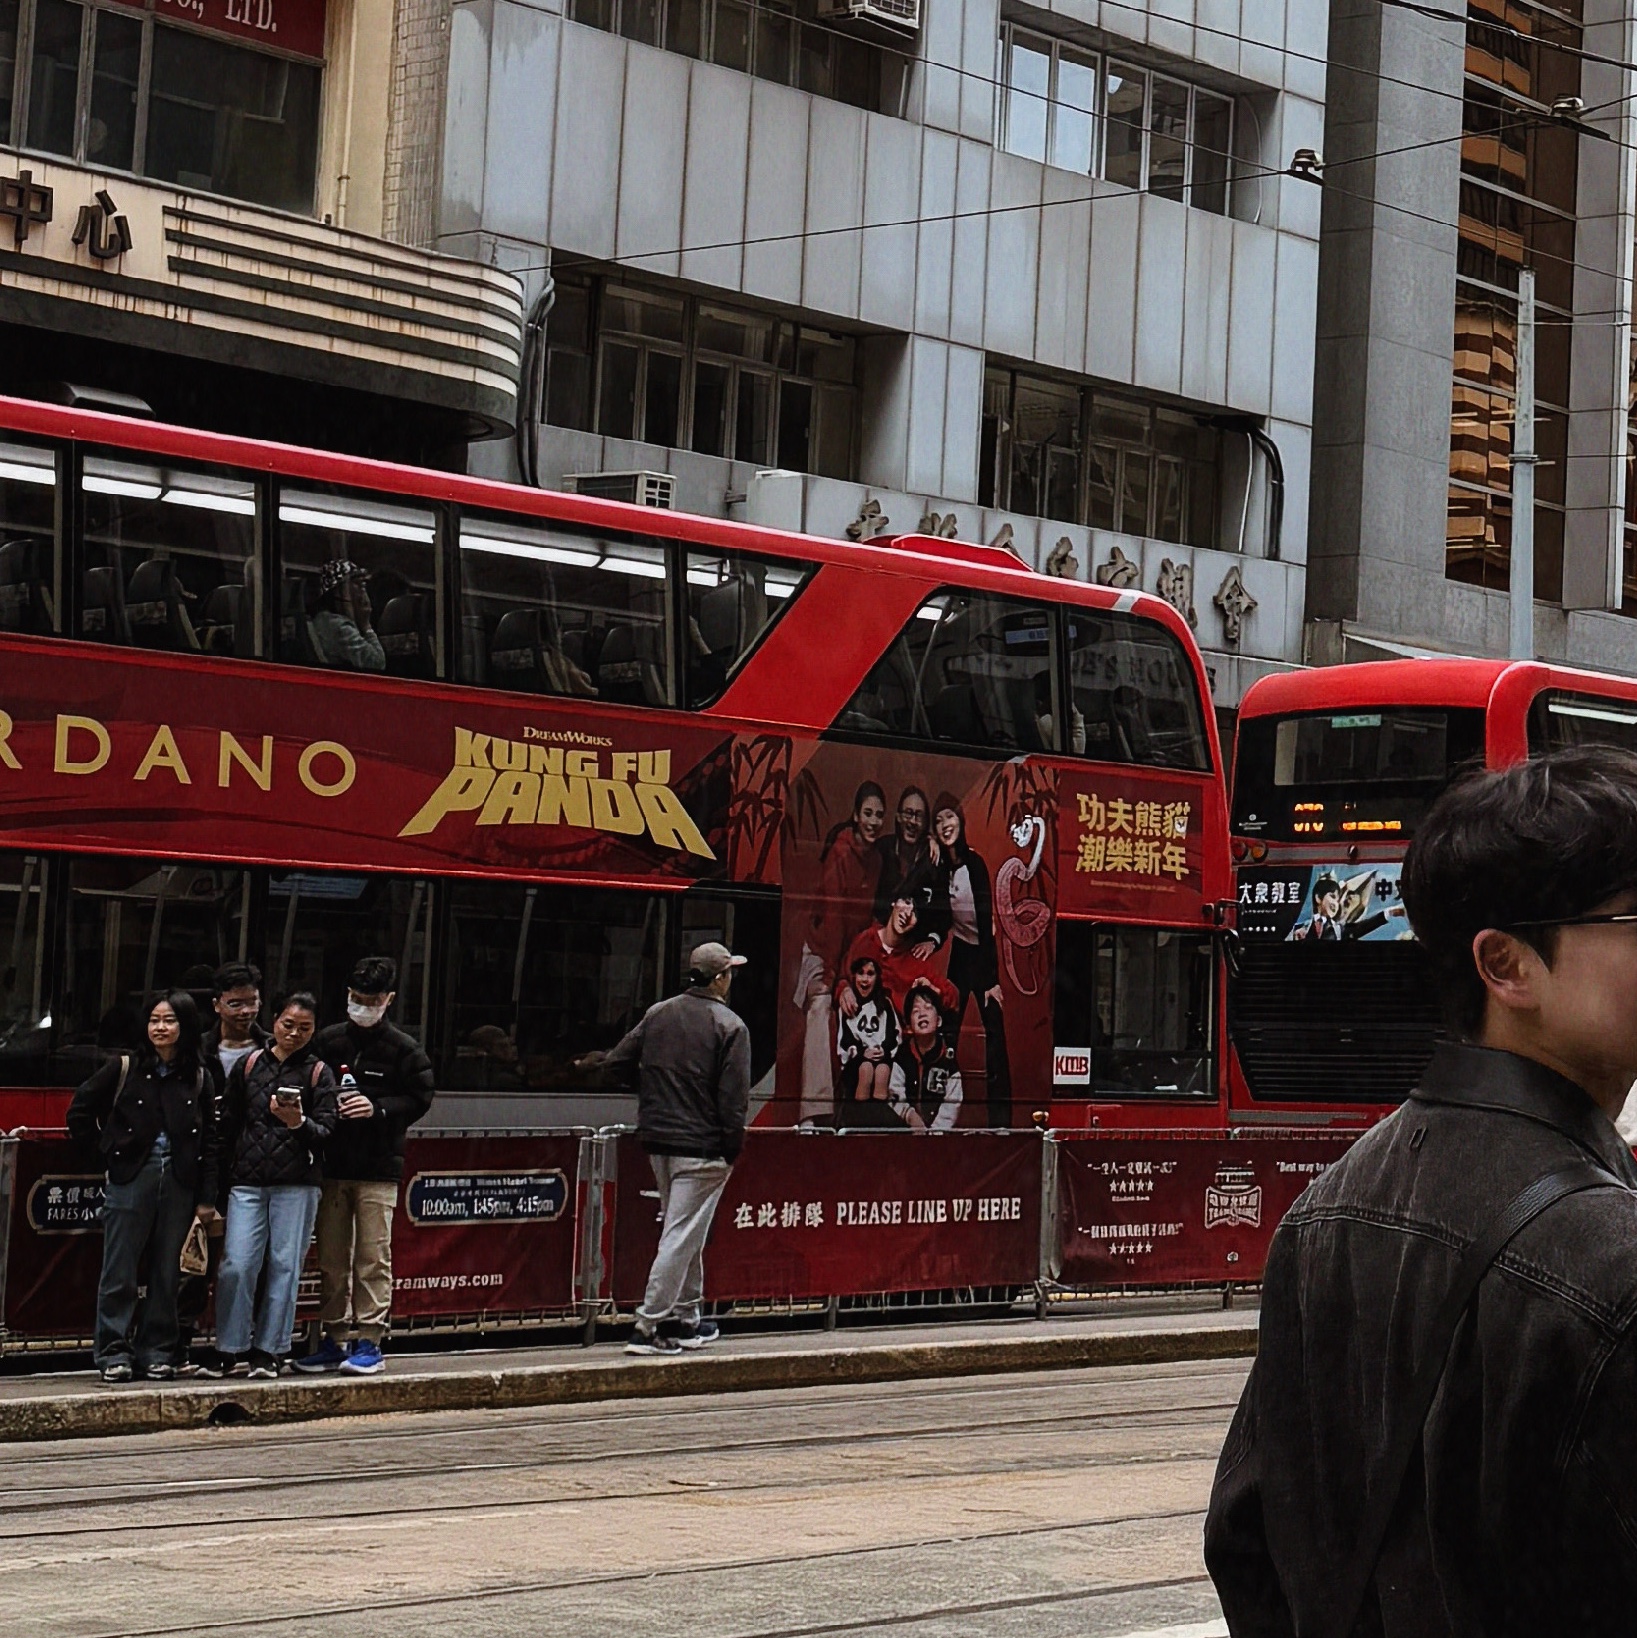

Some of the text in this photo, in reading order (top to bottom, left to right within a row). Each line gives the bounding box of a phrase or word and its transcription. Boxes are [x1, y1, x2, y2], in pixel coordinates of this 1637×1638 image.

[224, 0, 277, 33] LTD.
[0, 170, 132, 259] 中心
[455, 726, 671, 785] KUNG FU
[396, 765, 717, 860] PANDA
[1076, 793, 1191, 840] 功夫熊貓
[1075, 833, 1190, 881] 潮樂新年
[1055, 1055, 1089, 1075] KMB
[47, 1207, 79, 1221] FARES
[733, 1198, 1022, 1229] 在此排隊 PLEASE LINE UP HERE
